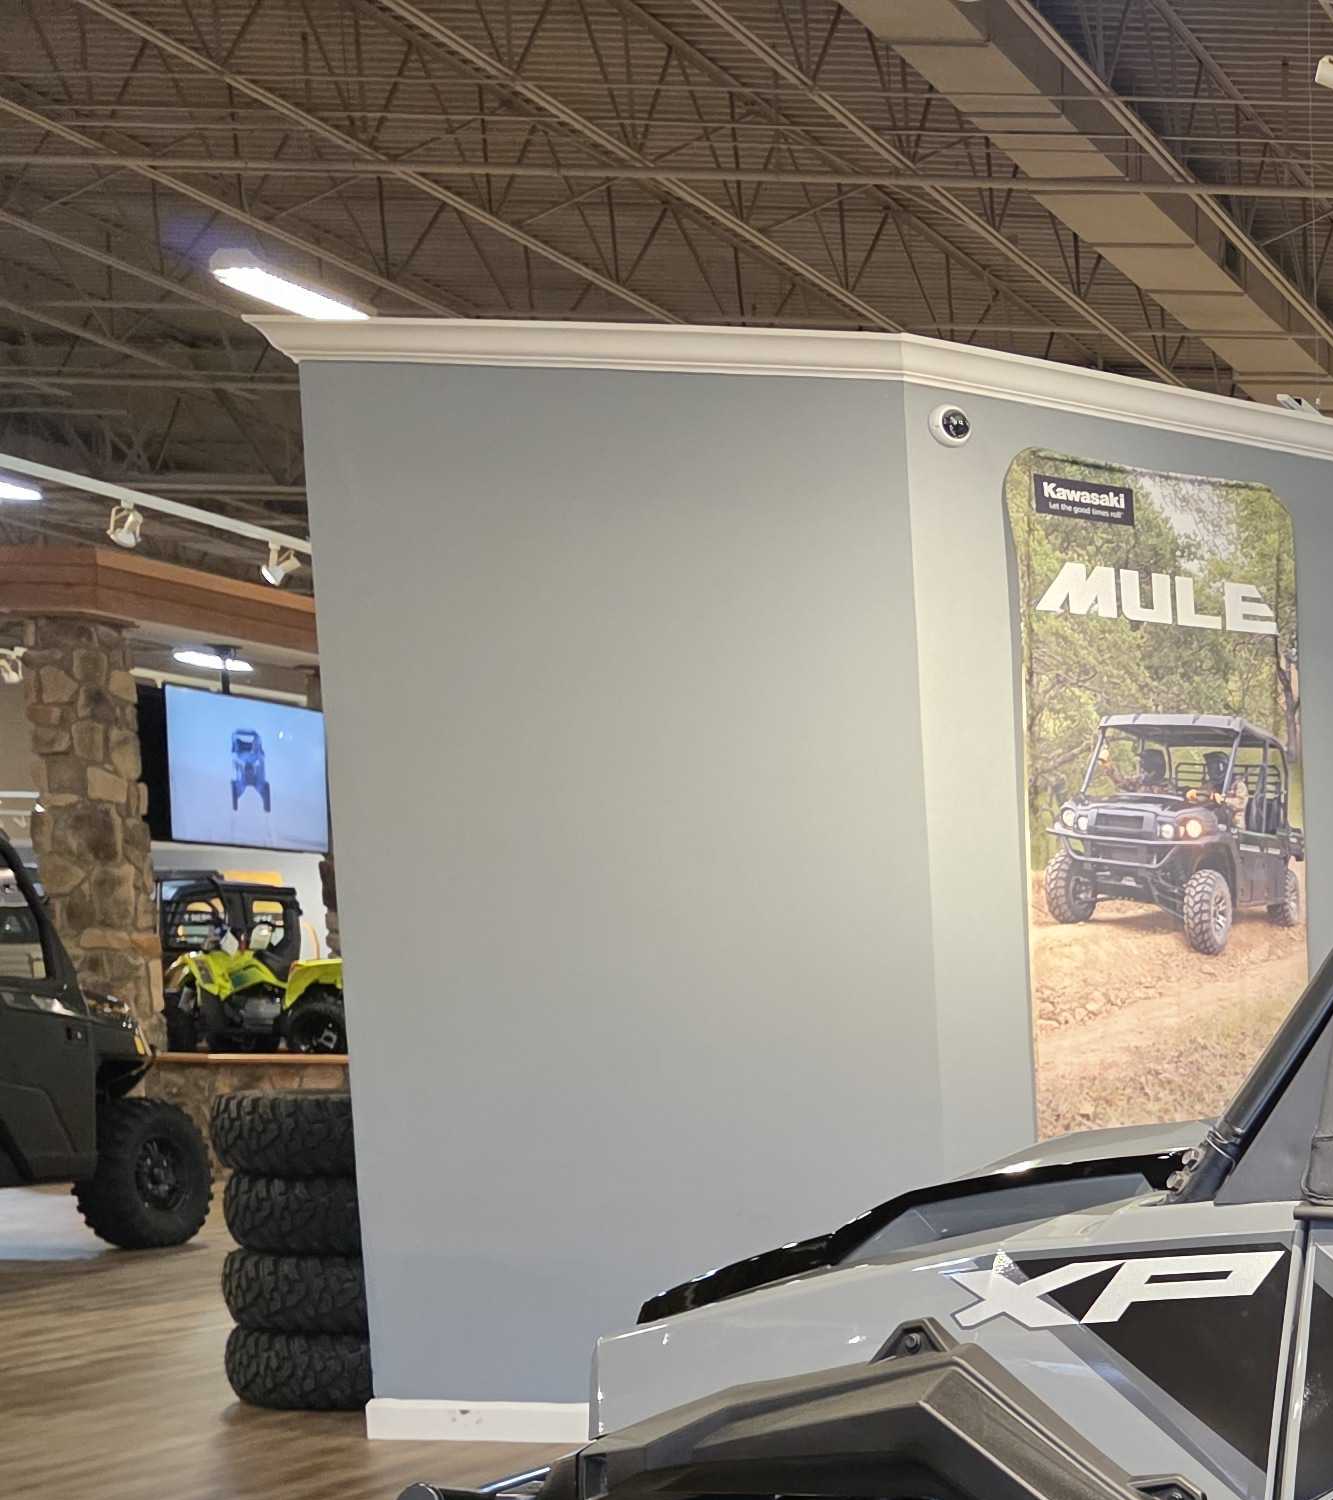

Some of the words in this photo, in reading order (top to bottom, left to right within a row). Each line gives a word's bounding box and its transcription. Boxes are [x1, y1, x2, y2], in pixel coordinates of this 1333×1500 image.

[1042, 481, 1126, 509] Kawasaki
[1060, 503, 1073, 512] the
[1036, 562, 1280, 637] MULE
[949, 1250, 1286, 1328] XP
